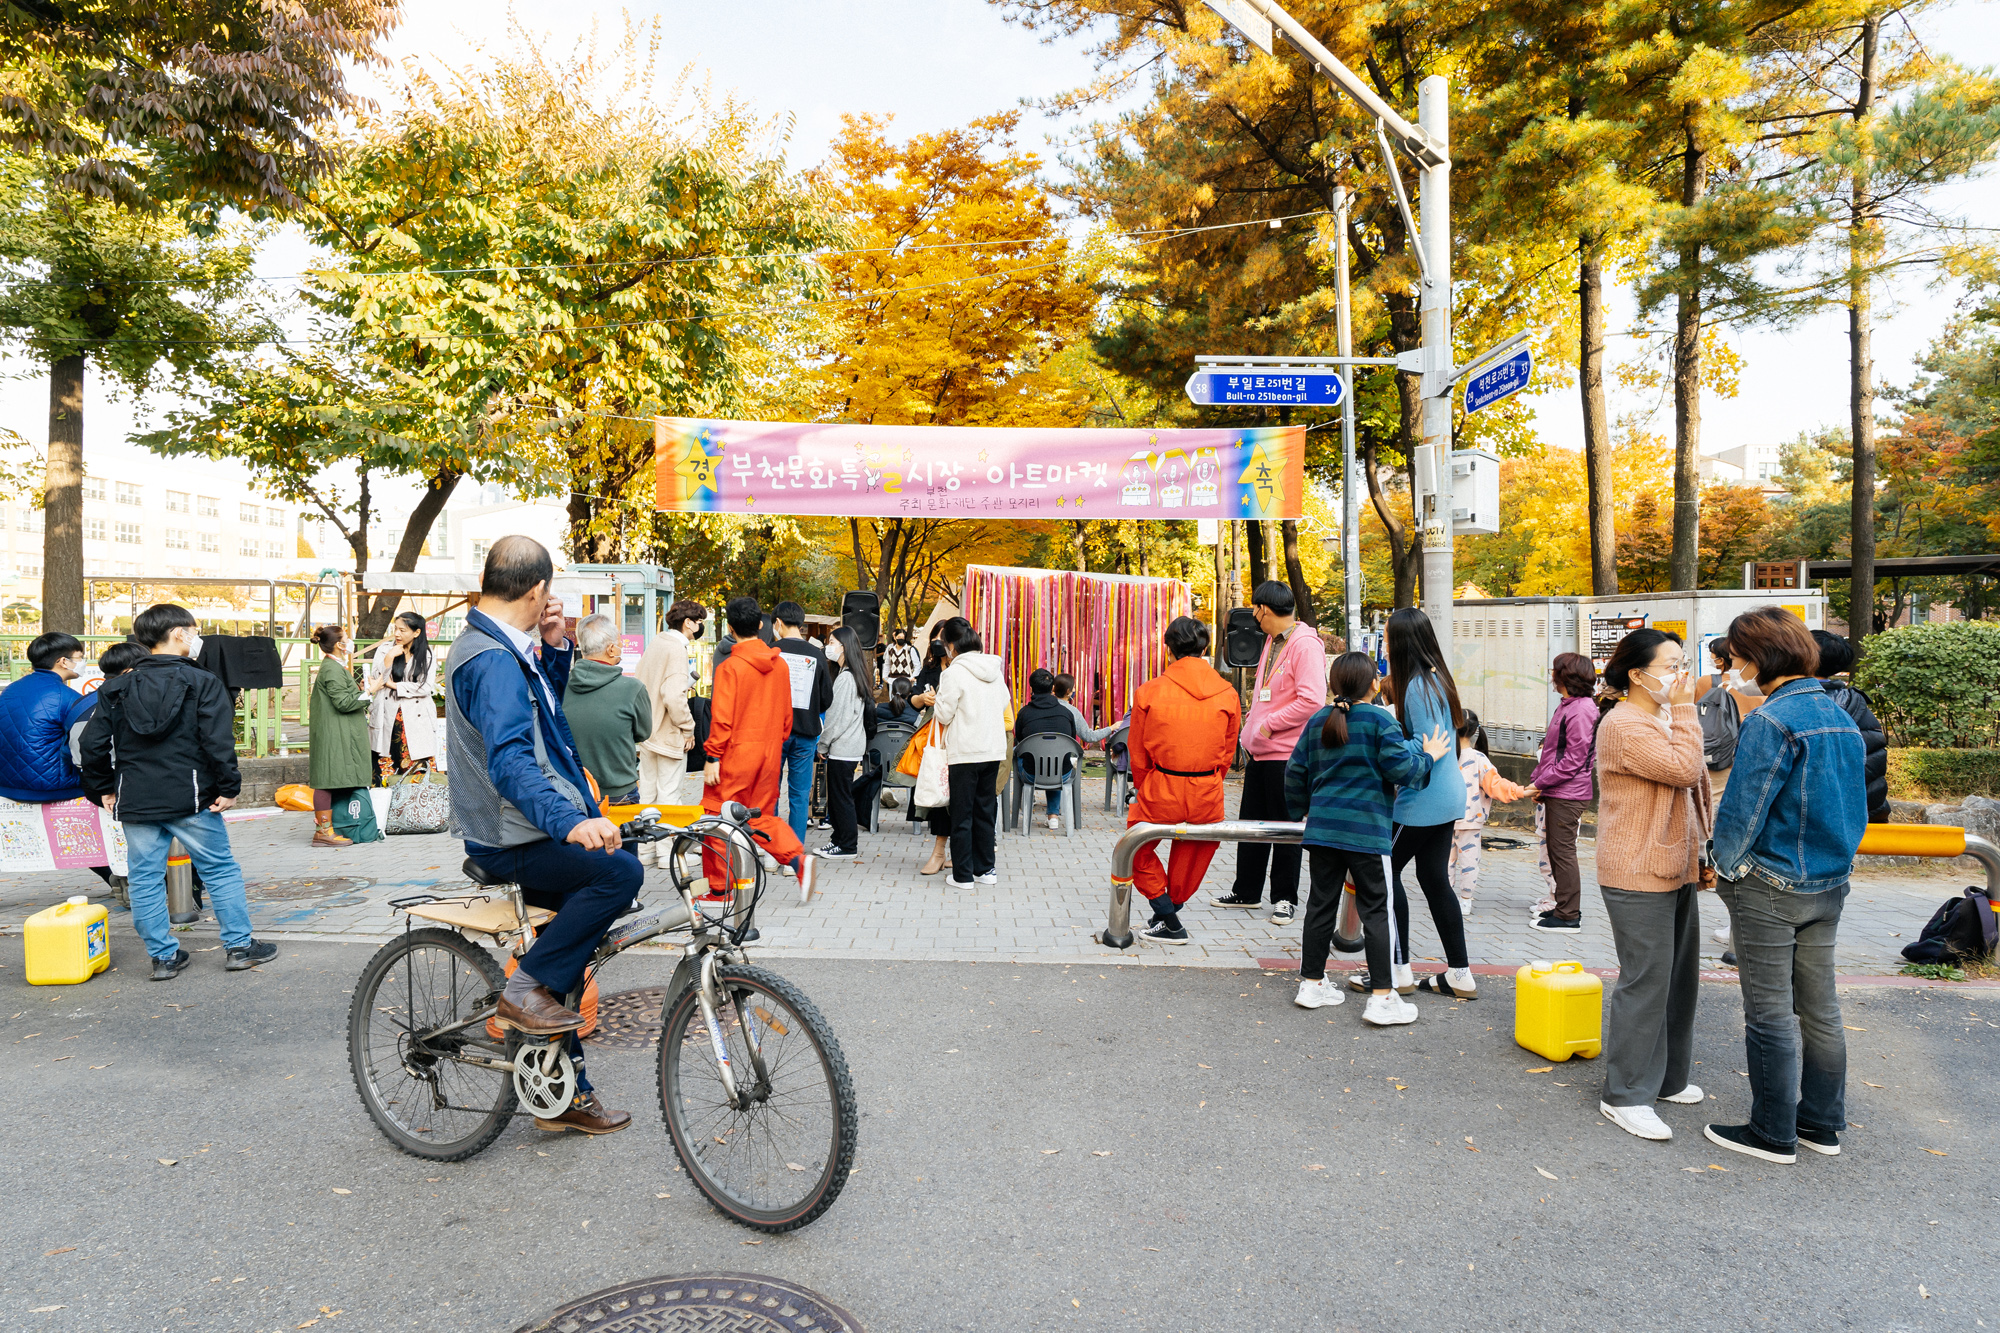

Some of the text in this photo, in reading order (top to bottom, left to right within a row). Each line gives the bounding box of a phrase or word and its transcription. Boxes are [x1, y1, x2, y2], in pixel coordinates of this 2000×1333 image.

[1521, 361, 1528, 376] 33
[1195, 383, 1208, 394] 38
[1227, 376, 1306, 391] 부일로251번길
[1325, 384, 1337, 395] 34
[1226, 391, 1308, 402] Buil-ro 251beon-gil
[1467, 391, 1474, 404] 29
[690, 459, 710, 481] 경
[986, 461, 1108, 489] 아트마켓
[1255, 462, 1274, 494] 축
[900, 498, 922, 511] 주최
[980, 496, 1002, 510] 주관
